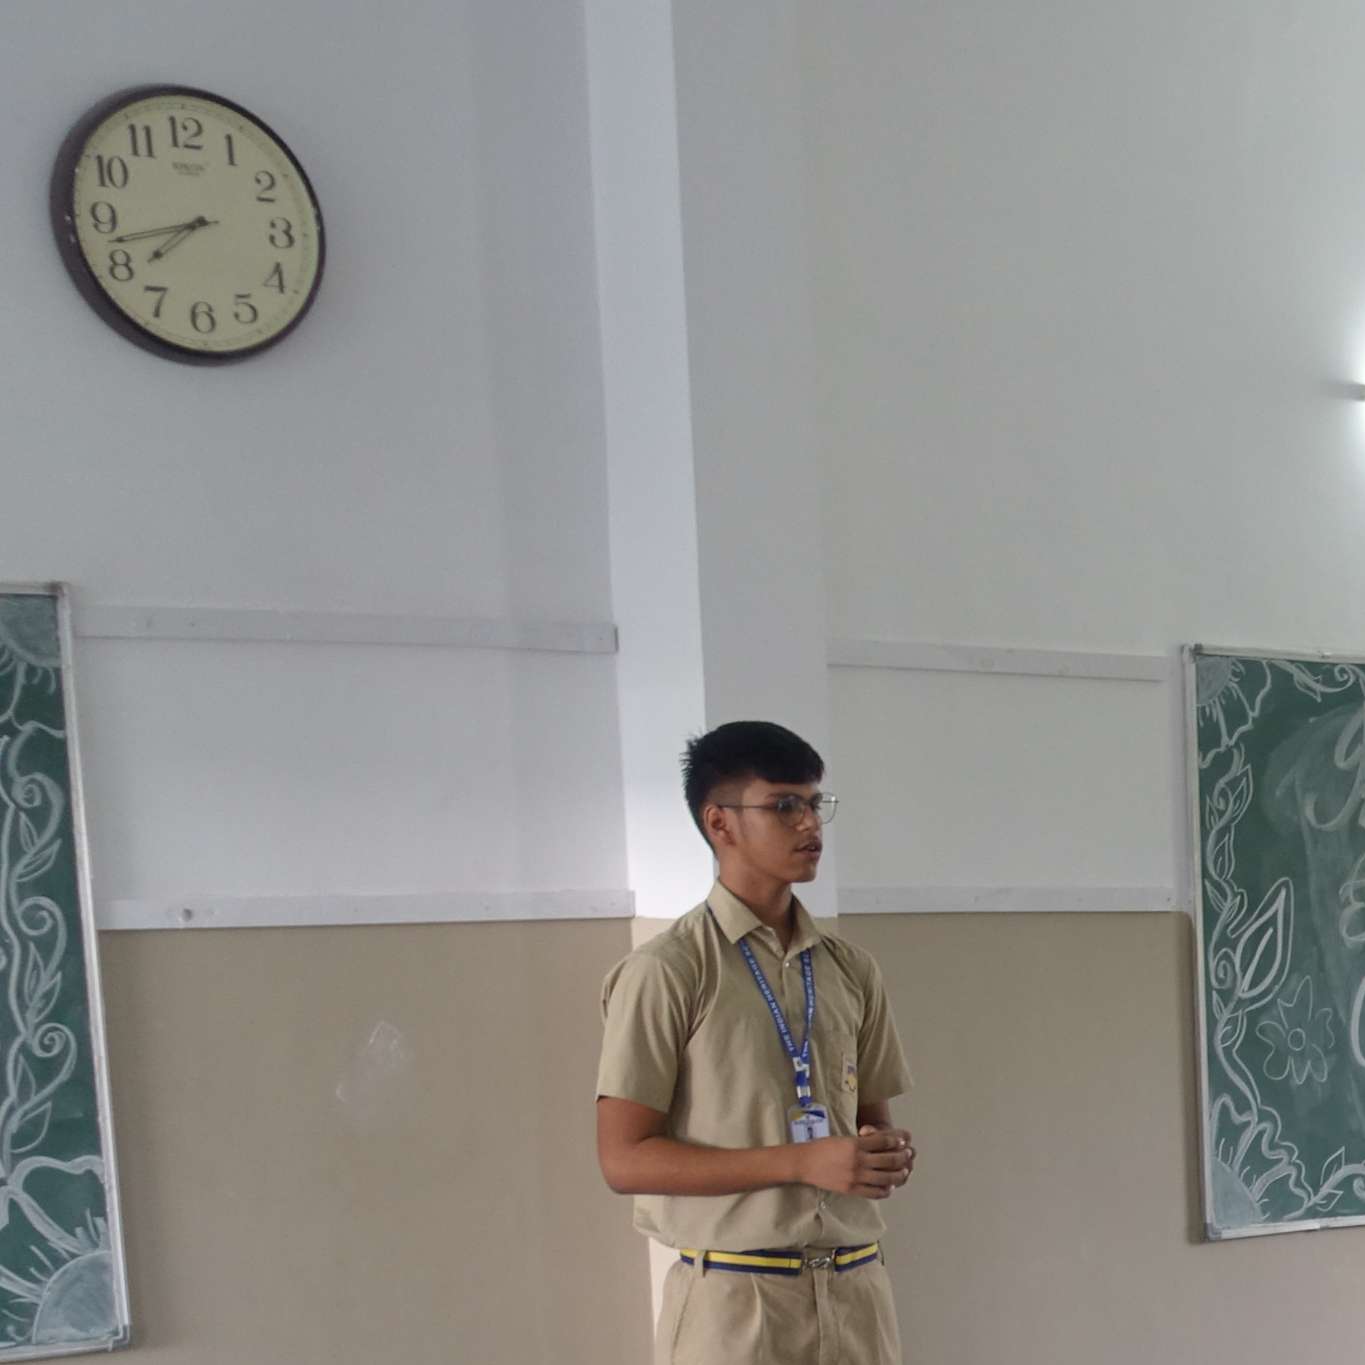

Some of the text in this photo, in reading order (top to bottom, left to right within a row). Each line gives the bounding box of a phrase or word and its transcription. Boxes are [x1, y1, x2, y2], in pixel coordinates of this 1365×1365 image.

[128, 123, 156, 159] 11
[169, 115, 204, 151] 12
[224, 133, 239, 167] 1
[96, 154, 129, 189] 10
[254, 170, 276, 203] 2
[90, 201, 118, 234] 9
[269, 216, 295, 249] 3
[108, 249, 135, 282] 8
[263, 261, 286, 295] 4
[144, 285, 169, 318] 7
[190, 301, 216, 334] 6
[233, 293, 259, 325] 5
